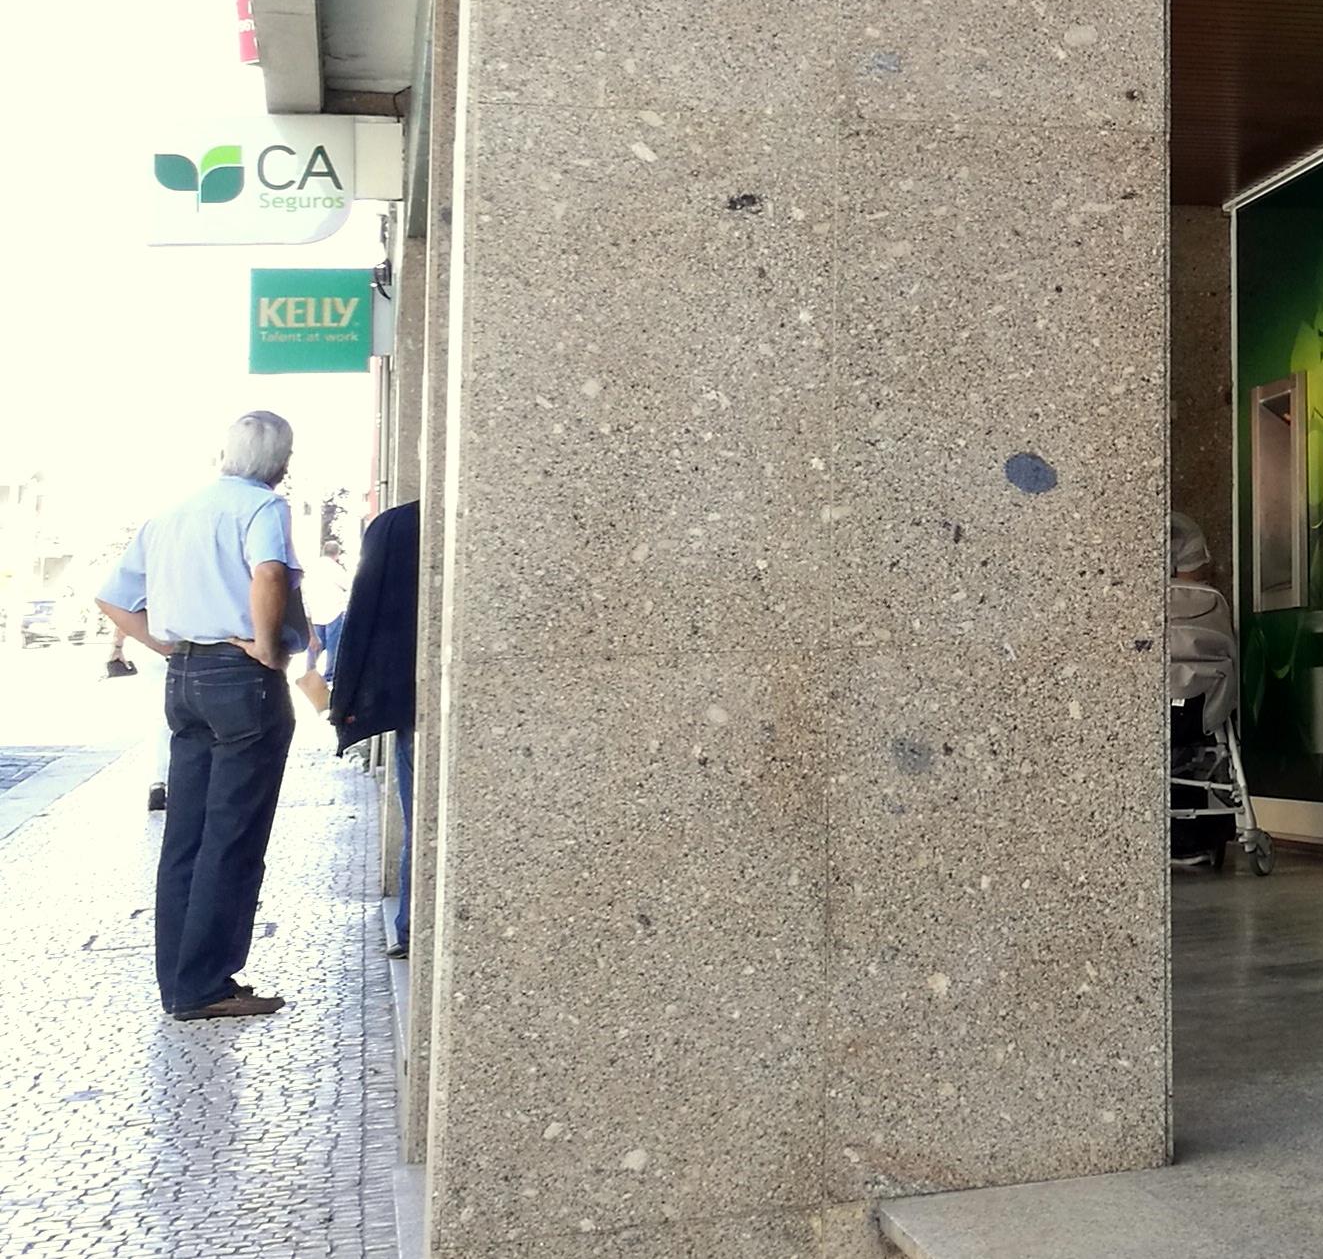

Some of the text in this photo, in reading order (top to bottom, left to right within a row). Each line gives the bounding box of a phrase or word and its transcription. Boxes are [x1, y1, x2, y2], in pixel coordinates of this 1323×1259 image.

[257, 145, 343, 190] CA
[259, 193, 345, 212] Seguros
[259, 297, 359, 328] KELLY
[325, 331, 359, 342] work
